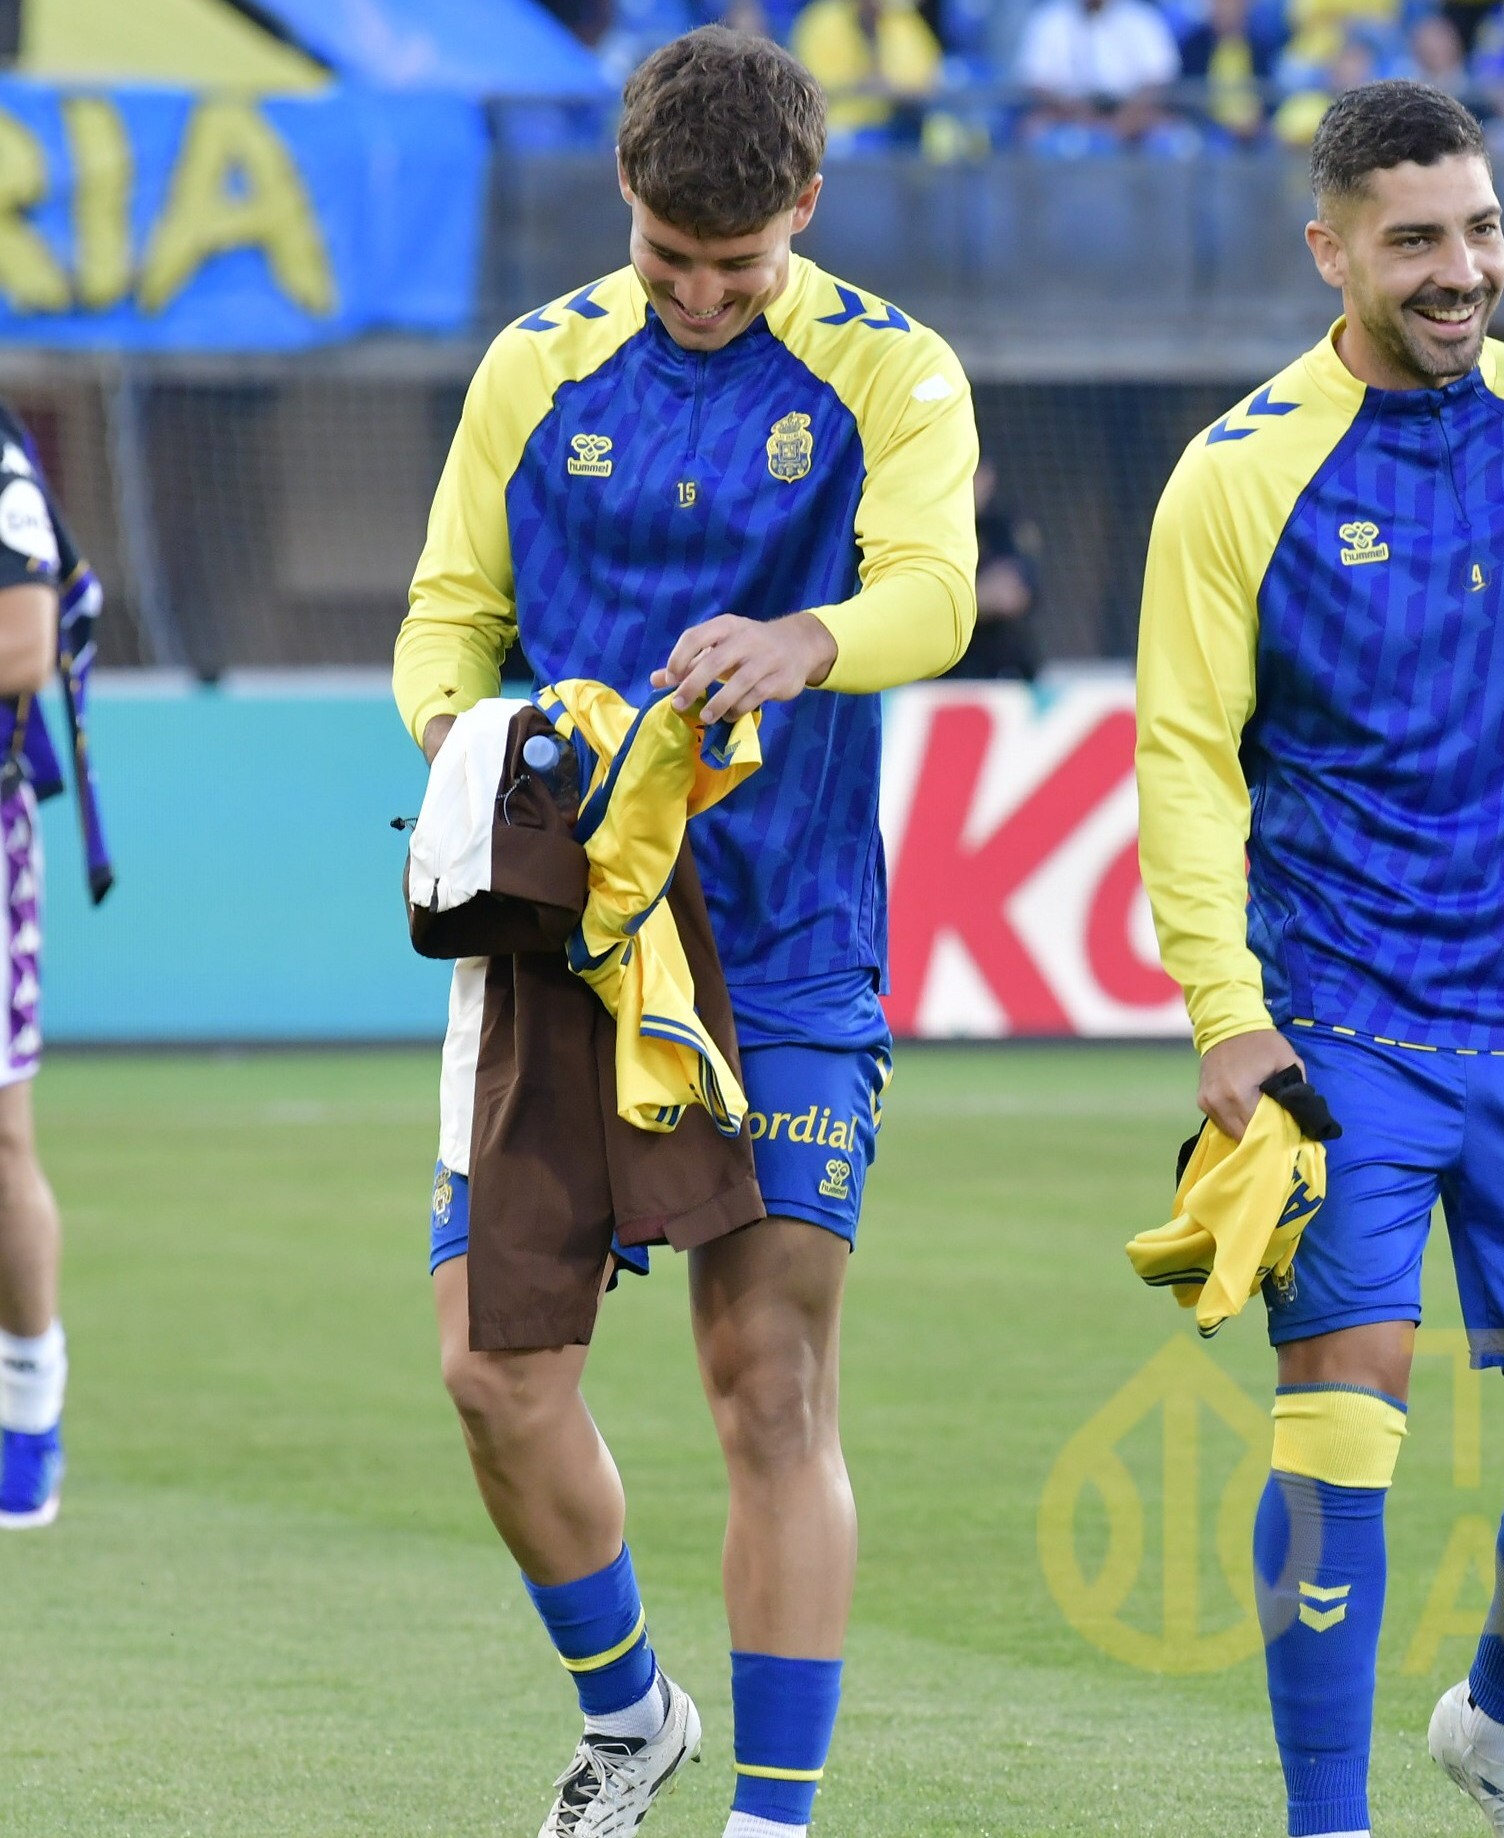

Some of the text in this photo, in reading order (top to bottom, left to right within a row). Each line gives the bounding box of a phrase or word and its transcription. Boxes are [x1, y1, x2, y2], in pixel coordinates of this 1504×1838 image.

[568, 460, 610, 474] hummel
[676, 481, 697, 502] 15
[1343, 547, 1387, 562] hummel
[749, 1105, 858, 1153] ordial
